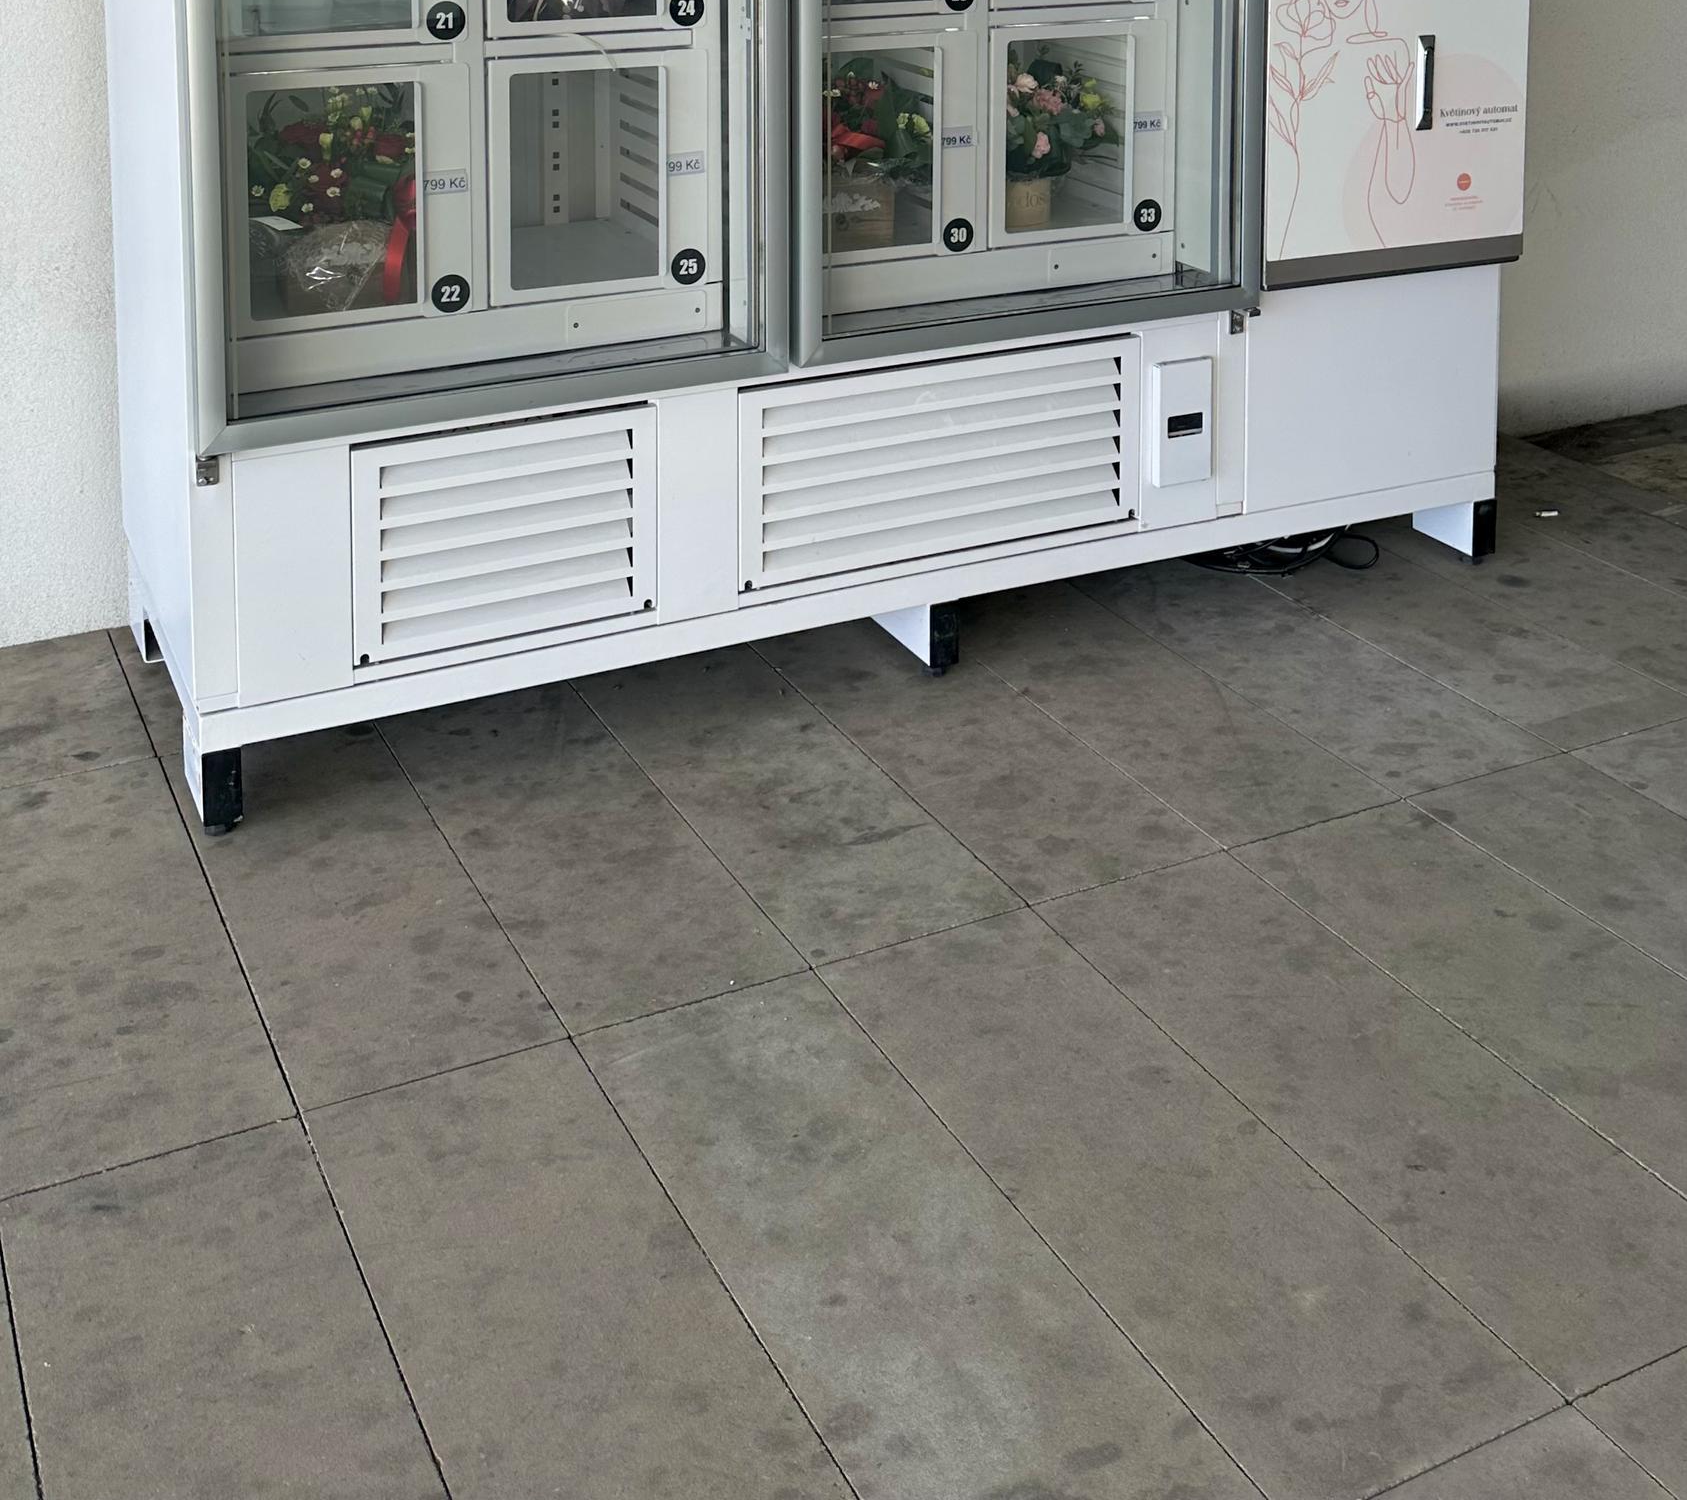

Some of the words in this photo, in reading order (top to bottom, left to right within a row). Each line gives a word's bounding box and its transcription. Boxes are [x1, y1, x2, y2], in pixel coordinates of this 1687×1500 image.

[677, 0, 695, 17] 24
[436, 12, 454, 30] 21
[1482, 105, 1518, 115] automat
[1133, 120, 1148, 130] 799
[1149, 118, 1161, 128] Kč
[942, 136, 957, 146] 799
[959, 134, 972, 145] Kč
[686, 158, 700, 170] Kč
[424, 179, 446, 191] 799
[450, 176, 466, 189] Kč
[1140, 208, 1156, 224] 33
[950, 227, 968, 243] 30
[679, 258, 698, 276] 25
[440, 284, 460, 302] 22
